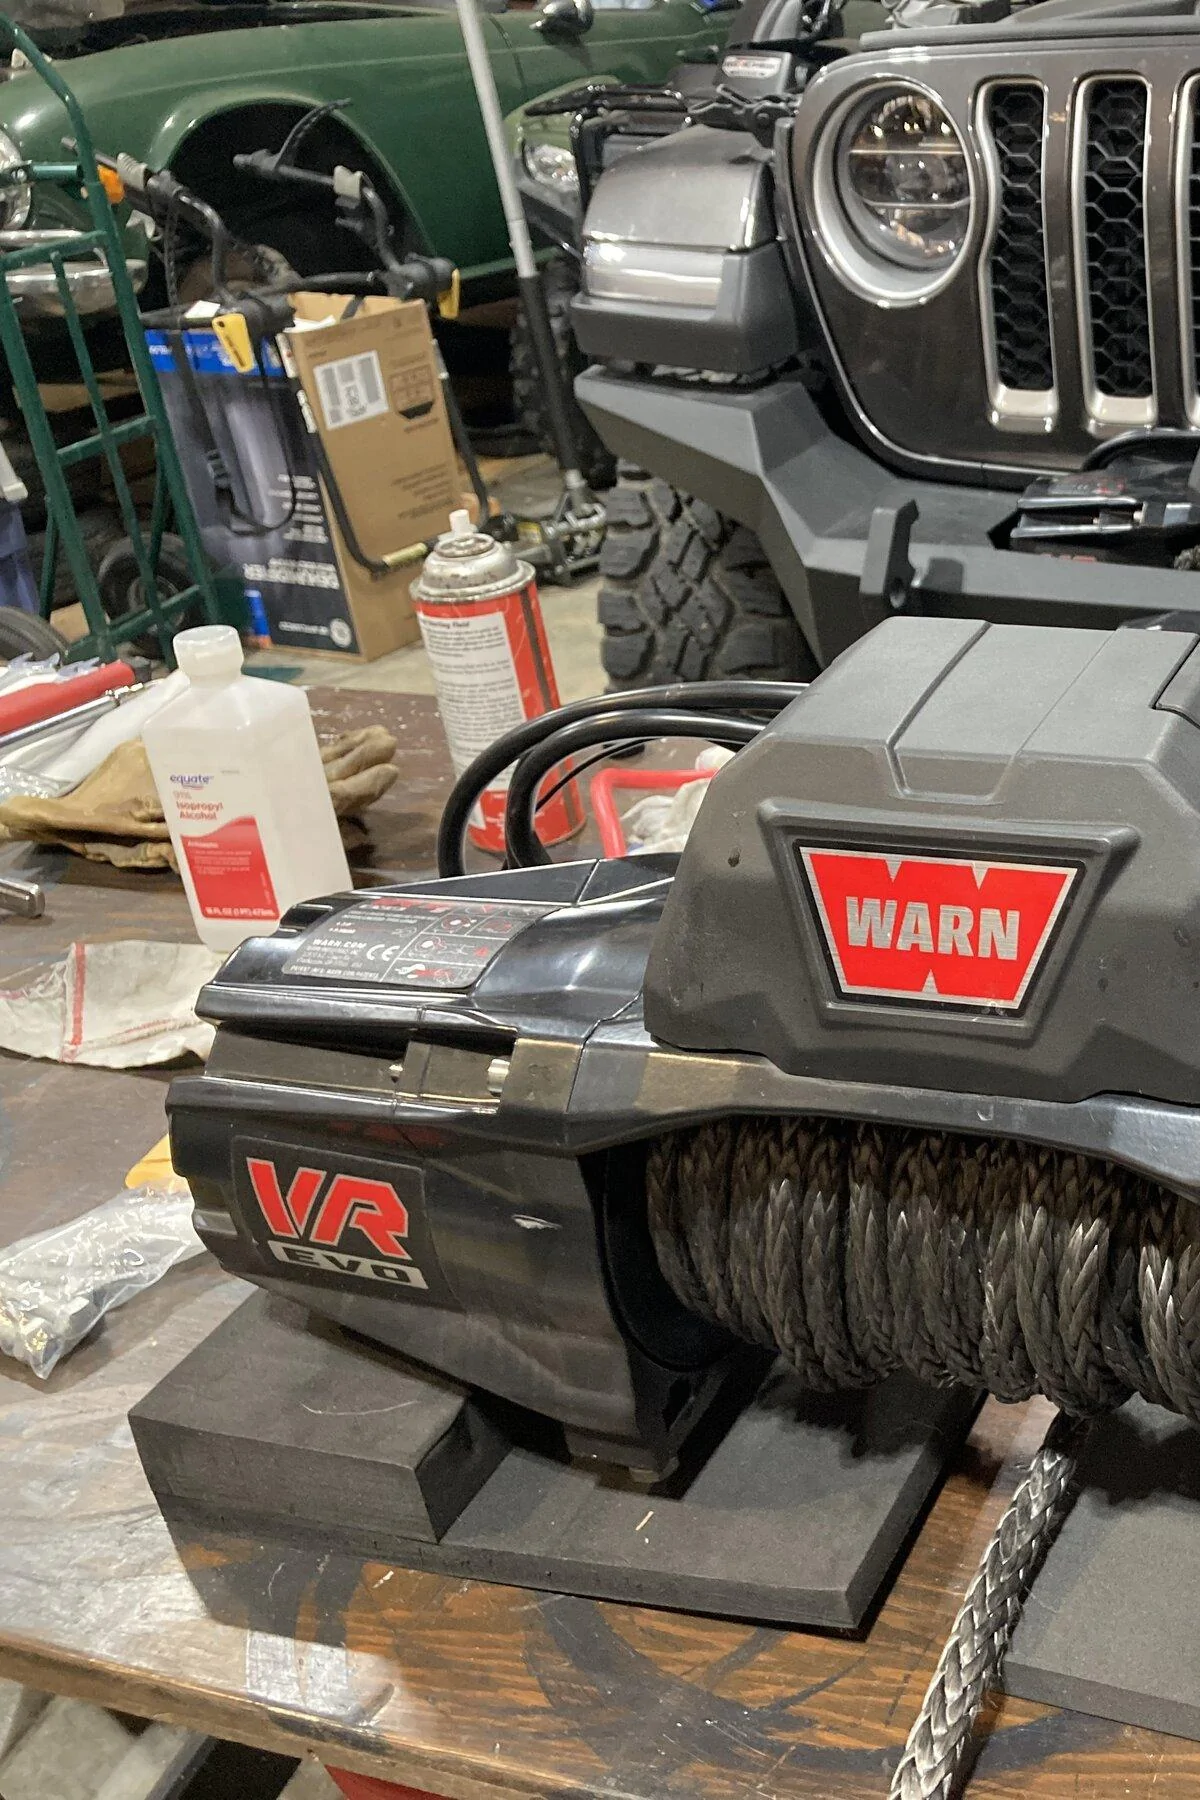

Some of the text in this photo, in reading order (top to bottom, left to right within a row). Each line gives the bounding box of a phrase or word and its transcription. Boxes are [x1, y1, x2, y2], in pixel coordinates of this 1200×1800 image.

[170, 774, 210, 787] equate
[176, 800, 224, 812] Isopropyl
[180, 811, 218, 820] Alcohol
[845, 896, 1021, 961] WARN
[313, 939, 368, 949] WARN.COM
[246, 1157, 413, 1261] VR
[274, 1244, 418, 1285] EVO
